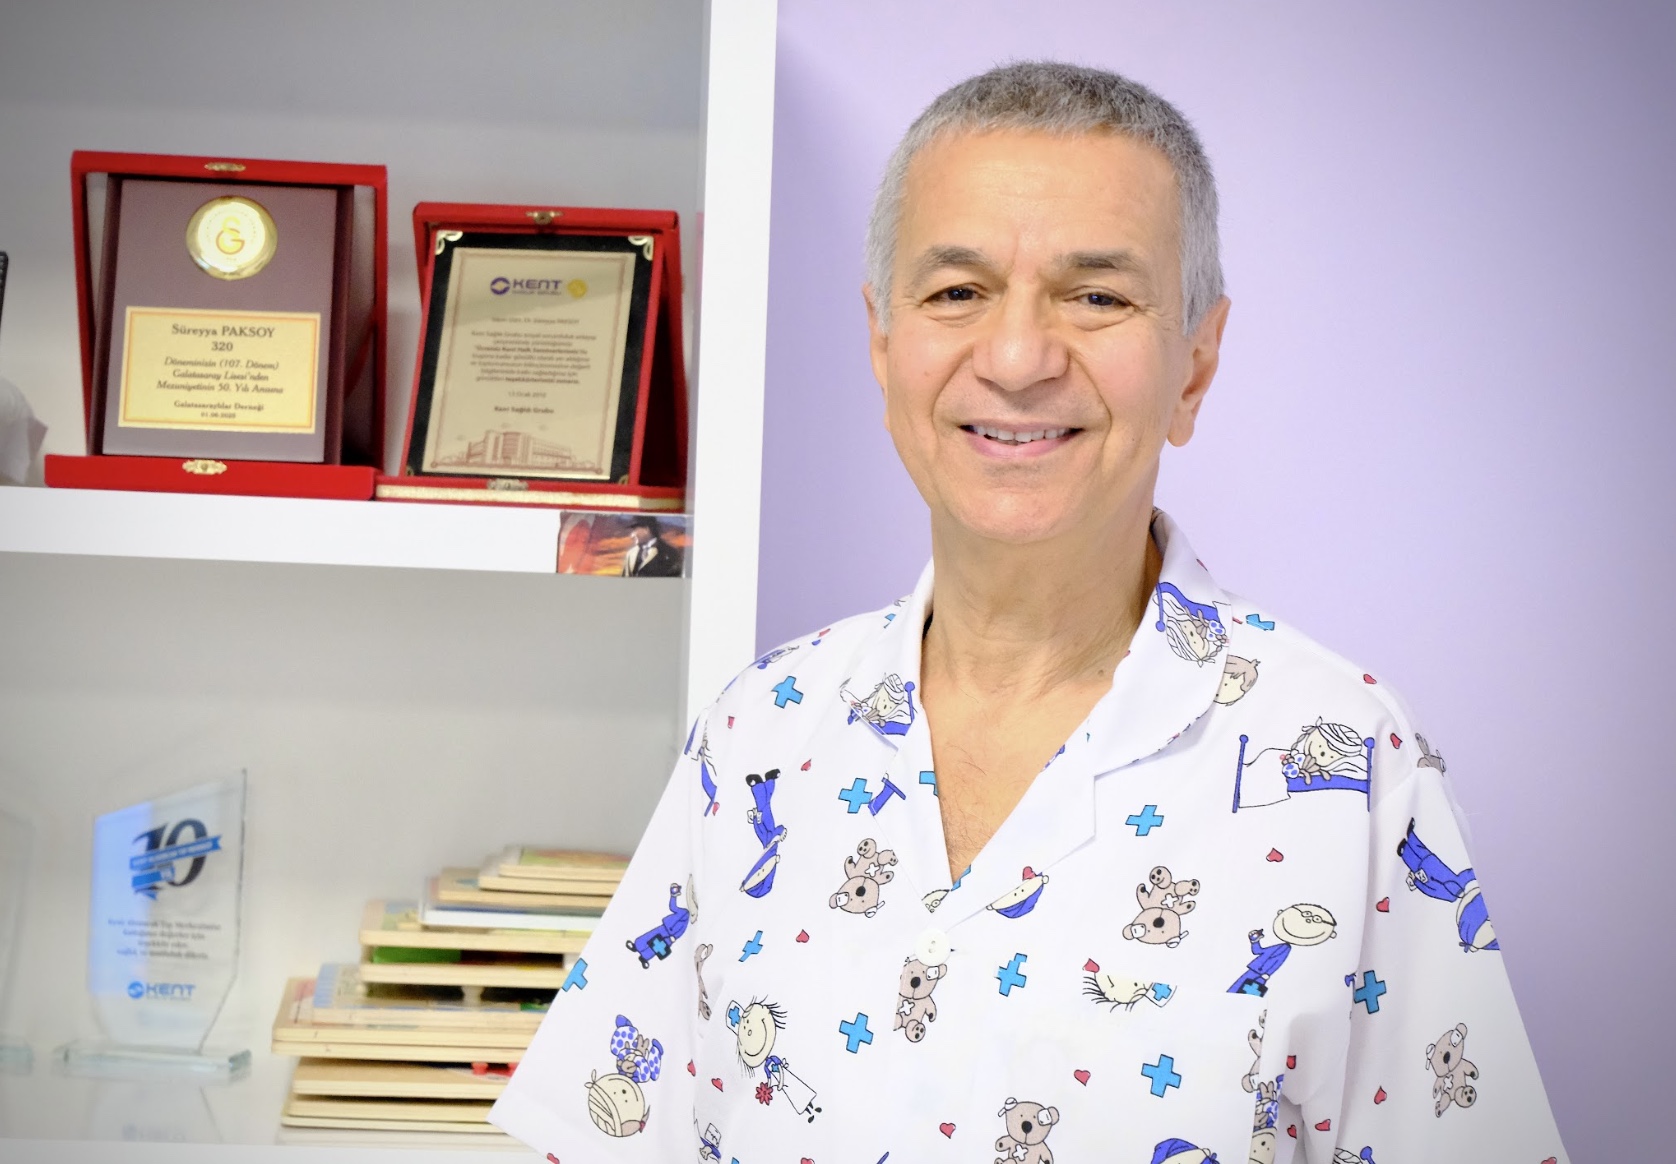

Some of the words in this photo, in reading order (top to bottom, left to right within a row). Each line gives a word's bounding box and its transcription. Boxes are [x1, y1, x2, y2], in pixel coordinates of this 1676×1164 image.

[513, 279, 562, 290] KENT
[171, 323, 218, 337] Süreyya
[221, 325, 275, 338] PAKSOY
[211, 341, 234, 352] 320
[172, 368, 222, 380] Galatasaray
[132, 818, 208, 893] 10
[146, 982, 197, 996] KENT
